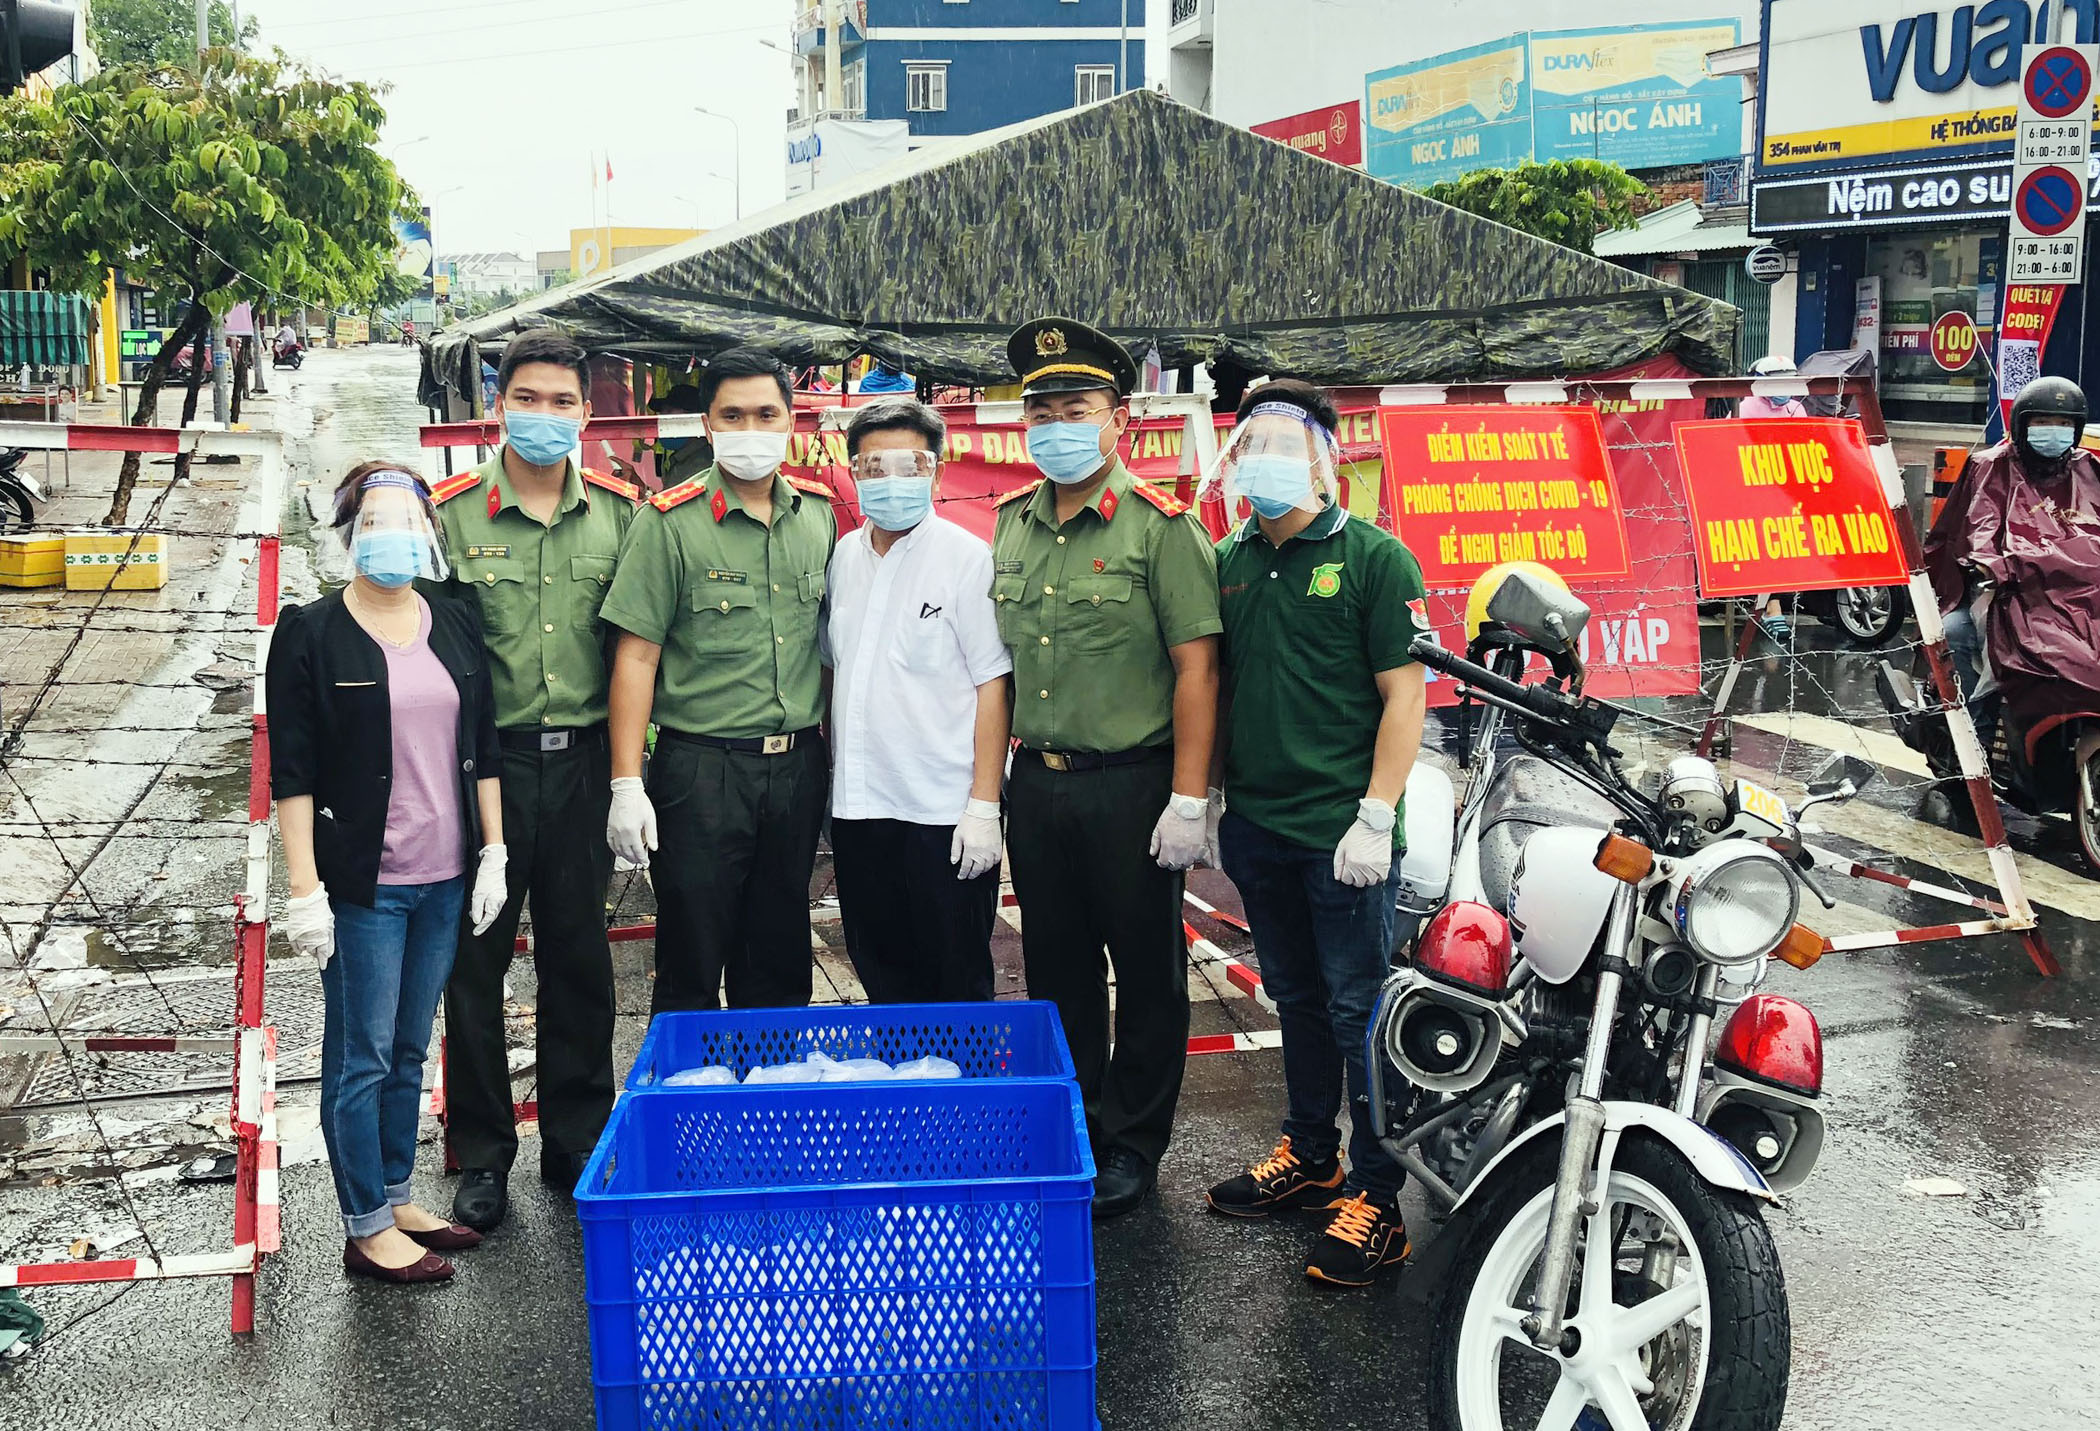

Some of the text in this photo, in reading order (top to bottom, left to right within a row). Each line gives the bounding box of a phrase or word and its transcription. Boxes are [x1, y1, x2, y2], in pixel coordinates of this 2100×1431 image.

[1570, 101, 1702, 138] NGỌC ÁNH
[1930, 119, 1949, 142] HỆ
[1951, 111, 2001, 137] THỐNG
[1411, 132, 1480, 167] NGỌC ÁNH
[1769, 142, 1790, 158] 354
[1791, 144, 1812, 155] PHAN
[1827, 175, 2011, 221] Nệm cao su
[1901, 332, 1919, 348] PHÍ
[1936, 325, 1973, 350] 100
[1426, 420, 1570, 463] ĐIỂM KIỂM SOÁT Y TẾ
[1737, 439, 1834, 493] KHU VỰC
[1402, 476, 1453, 514] PHÒNG
[1454, 472, 1504, 513] CHỐNG
[1503, 480, 1539, 517] DỊCH
[1538, 479, 1580, 510] COVID
[1589, 479, 1609, 509] 19
[1460, 533, 1497, 568] NGHỊ
[1498, 521, 1537, 562] GIẢM
[1536, 520, 1566, 561] TỐC
[1565, 523, 1588, 565] ĐỘ
[1706, 501, 1889, 572] HẠN CHẾ RA VÀO
[1601, 602, 1671, 665] VẤP
